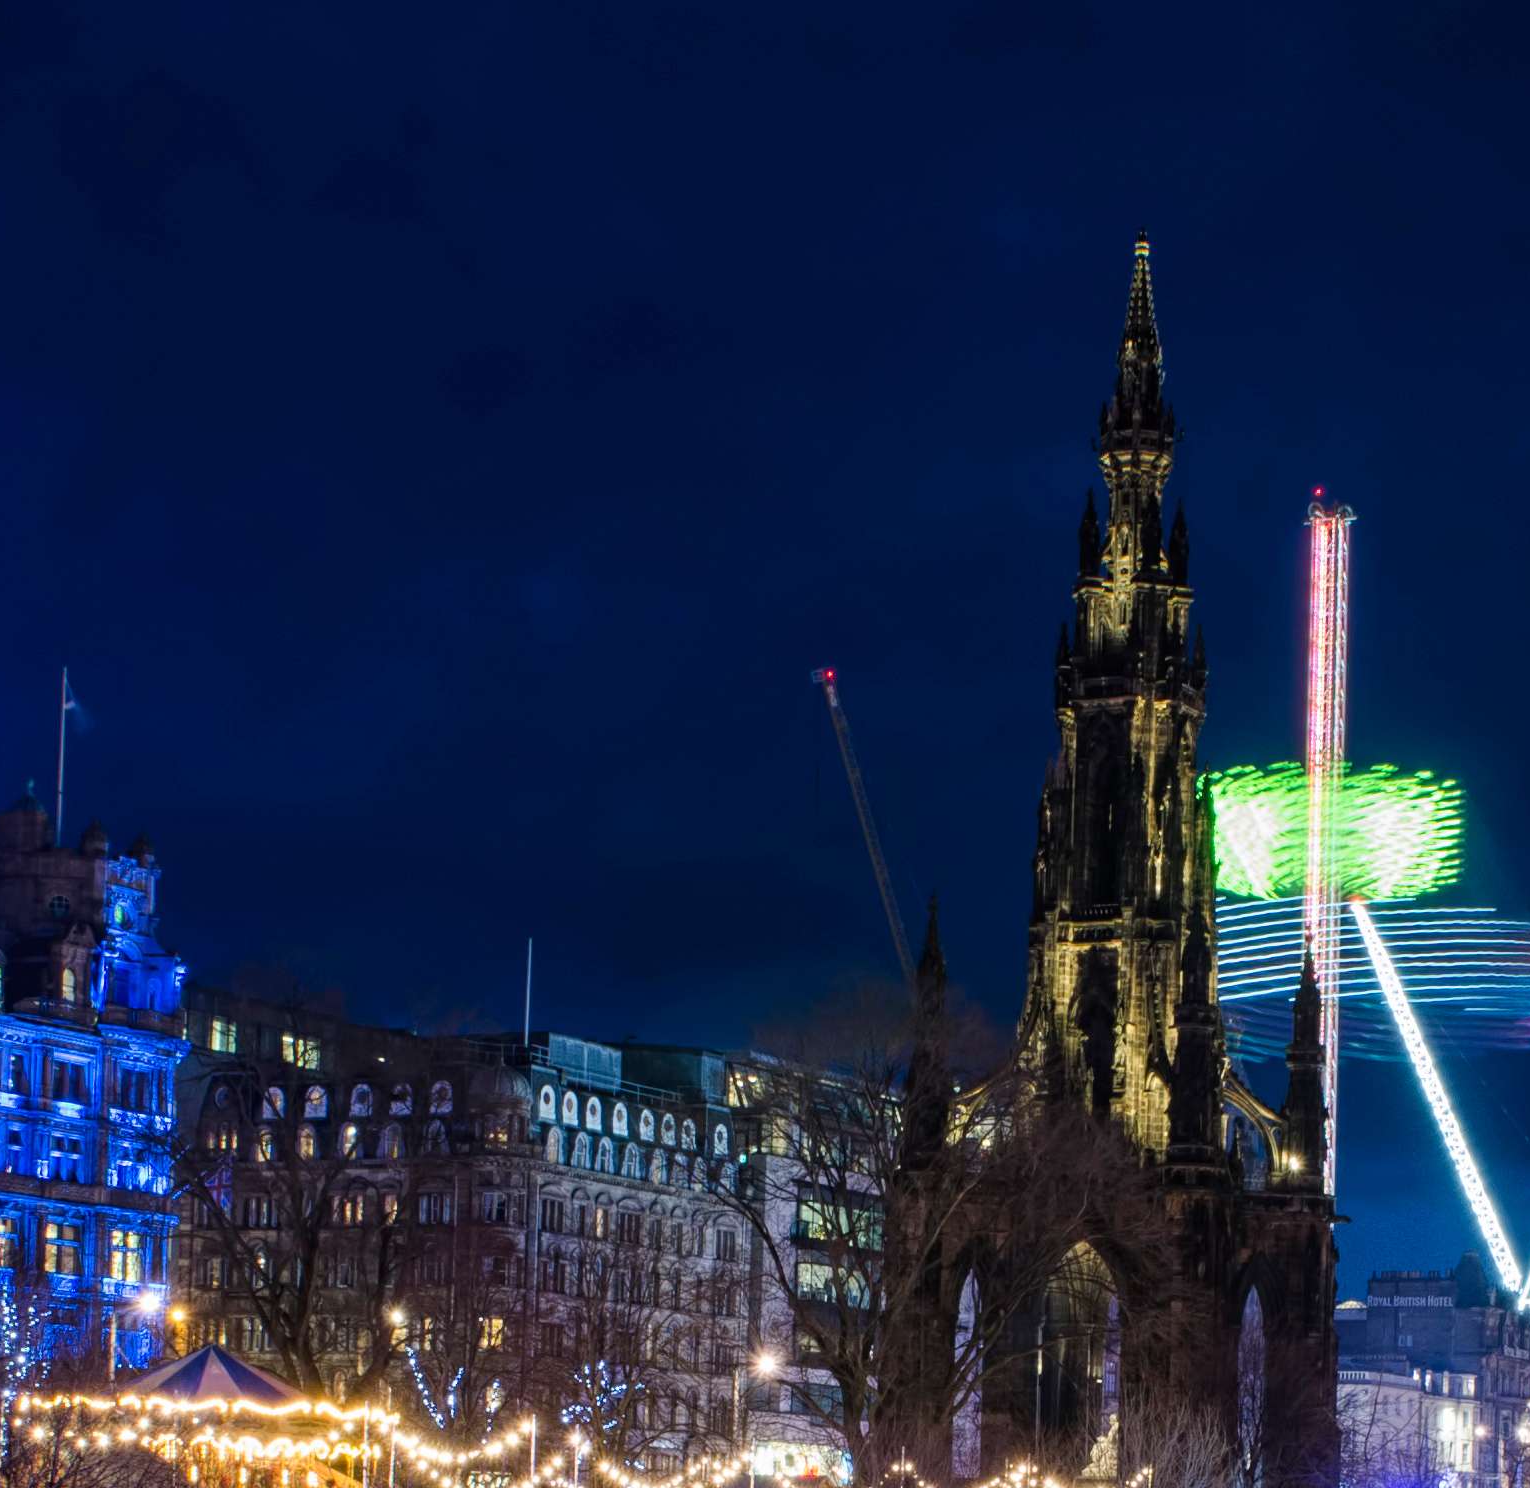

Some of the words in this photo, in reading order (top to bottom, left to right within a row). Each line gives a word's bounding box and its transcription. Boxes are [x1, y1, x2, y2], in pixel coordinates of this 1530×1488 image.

[1368, 1295, 1391, 1307] ROYAL
[1394, 1295, 1426, 1307] BRITISH
[1428, 1295, 1454, 1307] HOTEL
